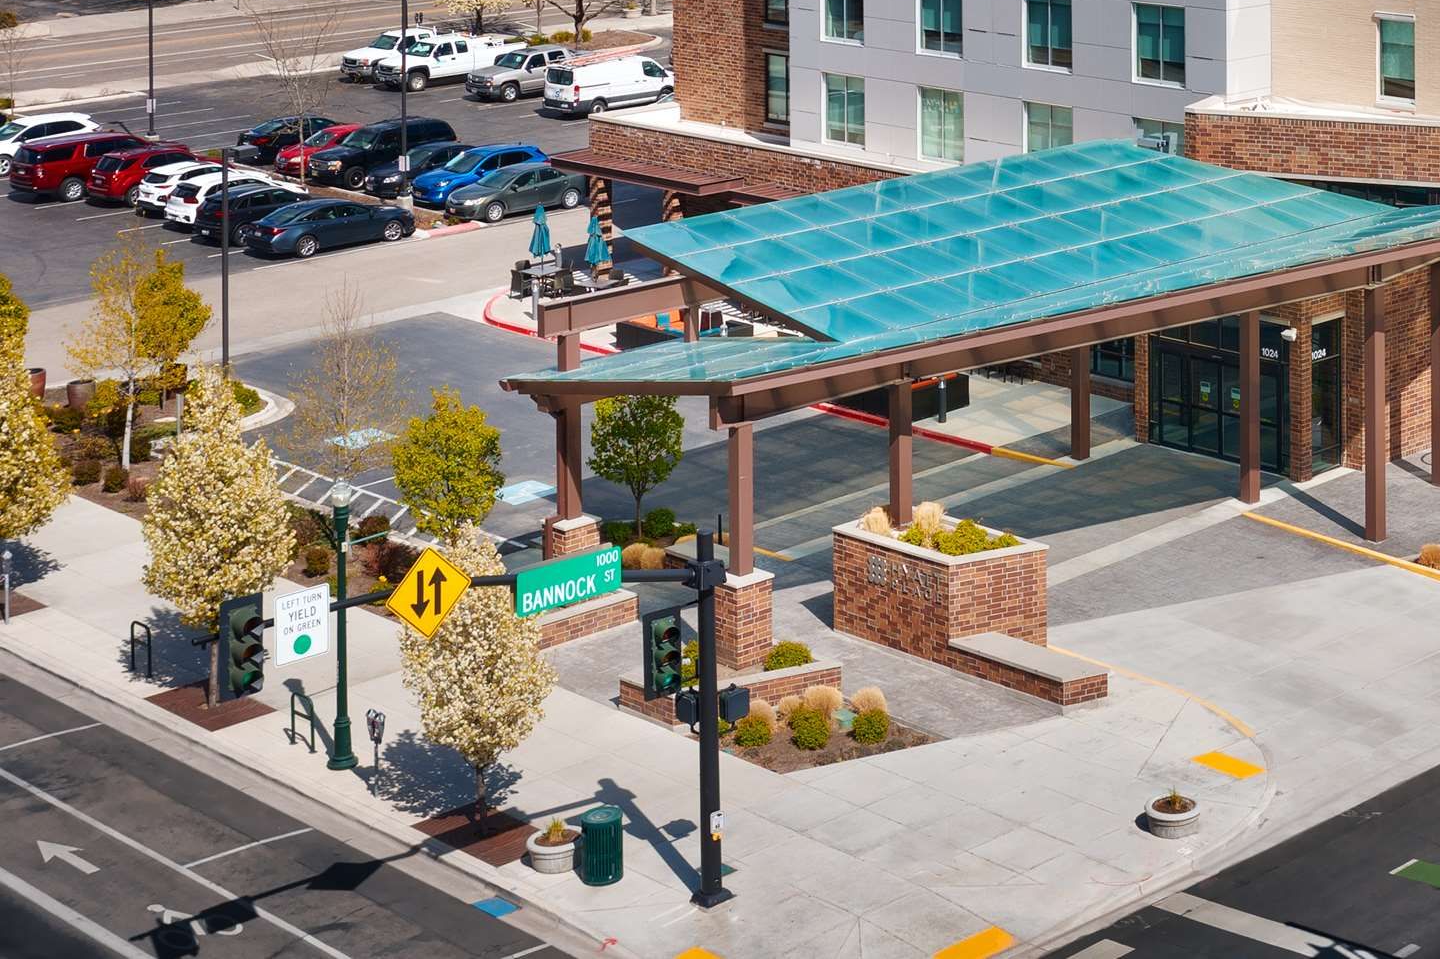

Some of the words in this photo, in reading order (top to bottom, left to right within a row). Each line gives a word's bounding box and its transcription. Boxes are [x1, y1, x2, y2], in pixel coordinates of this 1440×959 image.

[1262, 347, 1279, 359] 1024
[1311, 348, 1327, 360] 1024
[596, 549, 619, 567] 1000
[891, 561, 942, 591] HYATT
[522, 574, 596, 613] BANNOCK
[604, 568, 615, 582] ST
[891, 579, 943, 605] PLACE
[281, 598, 299, 610] LEFT
[303, 592, 322, 604] TURN
[289, 606, 316, 622] YIELD
[283, 625, 294, 635] ON
[297, 619, 321, 631] GREEN
